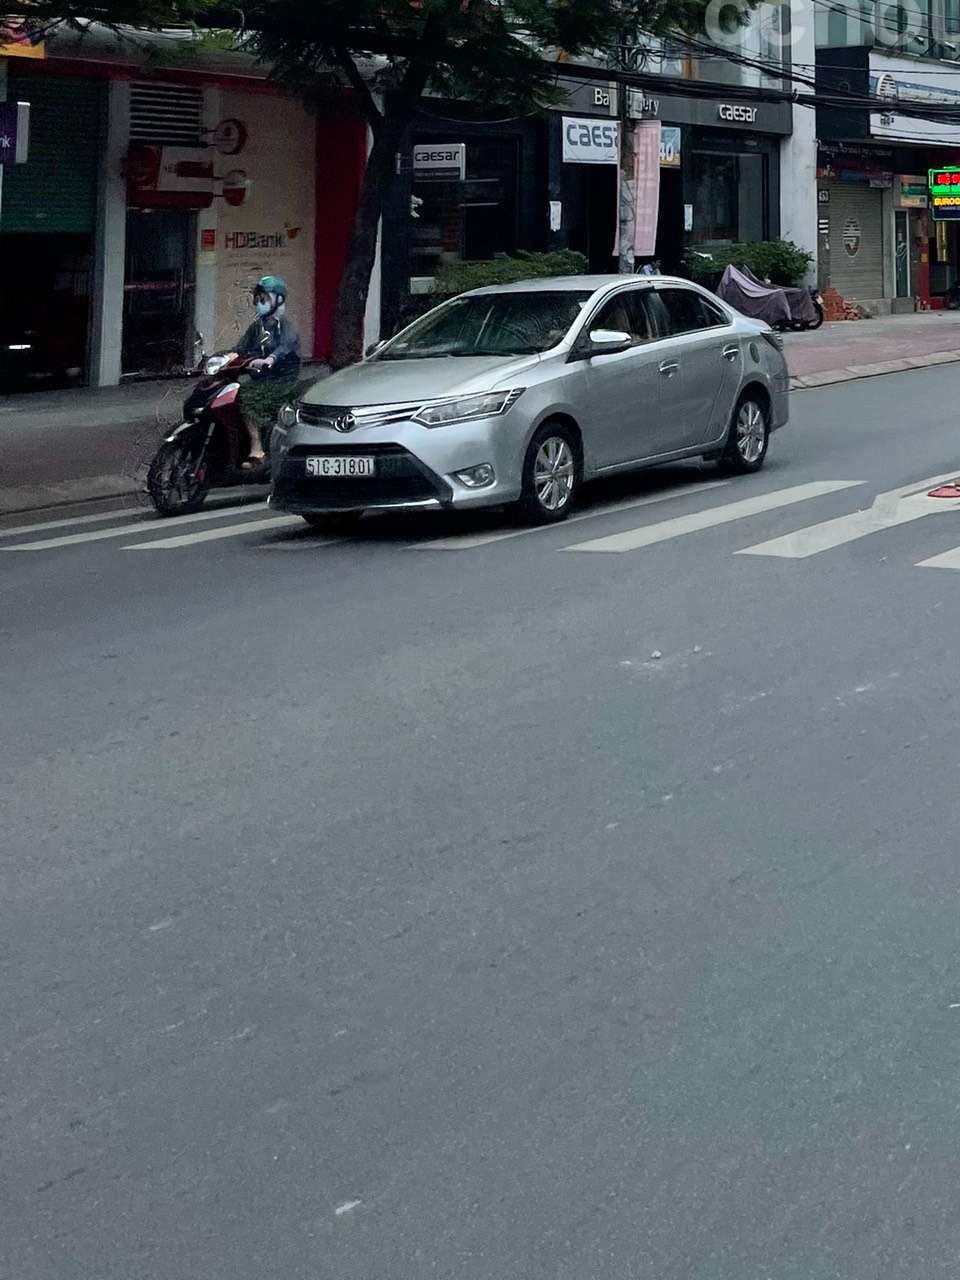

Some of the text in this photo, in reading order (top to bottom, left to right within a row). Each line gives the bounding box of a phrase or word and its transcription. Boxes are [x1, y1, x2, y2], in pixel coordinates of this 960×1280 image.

[719, 104, 757, 122] caesar
[566, 124, 618, 148] caes
[415, 151, 459, 162] caesar
